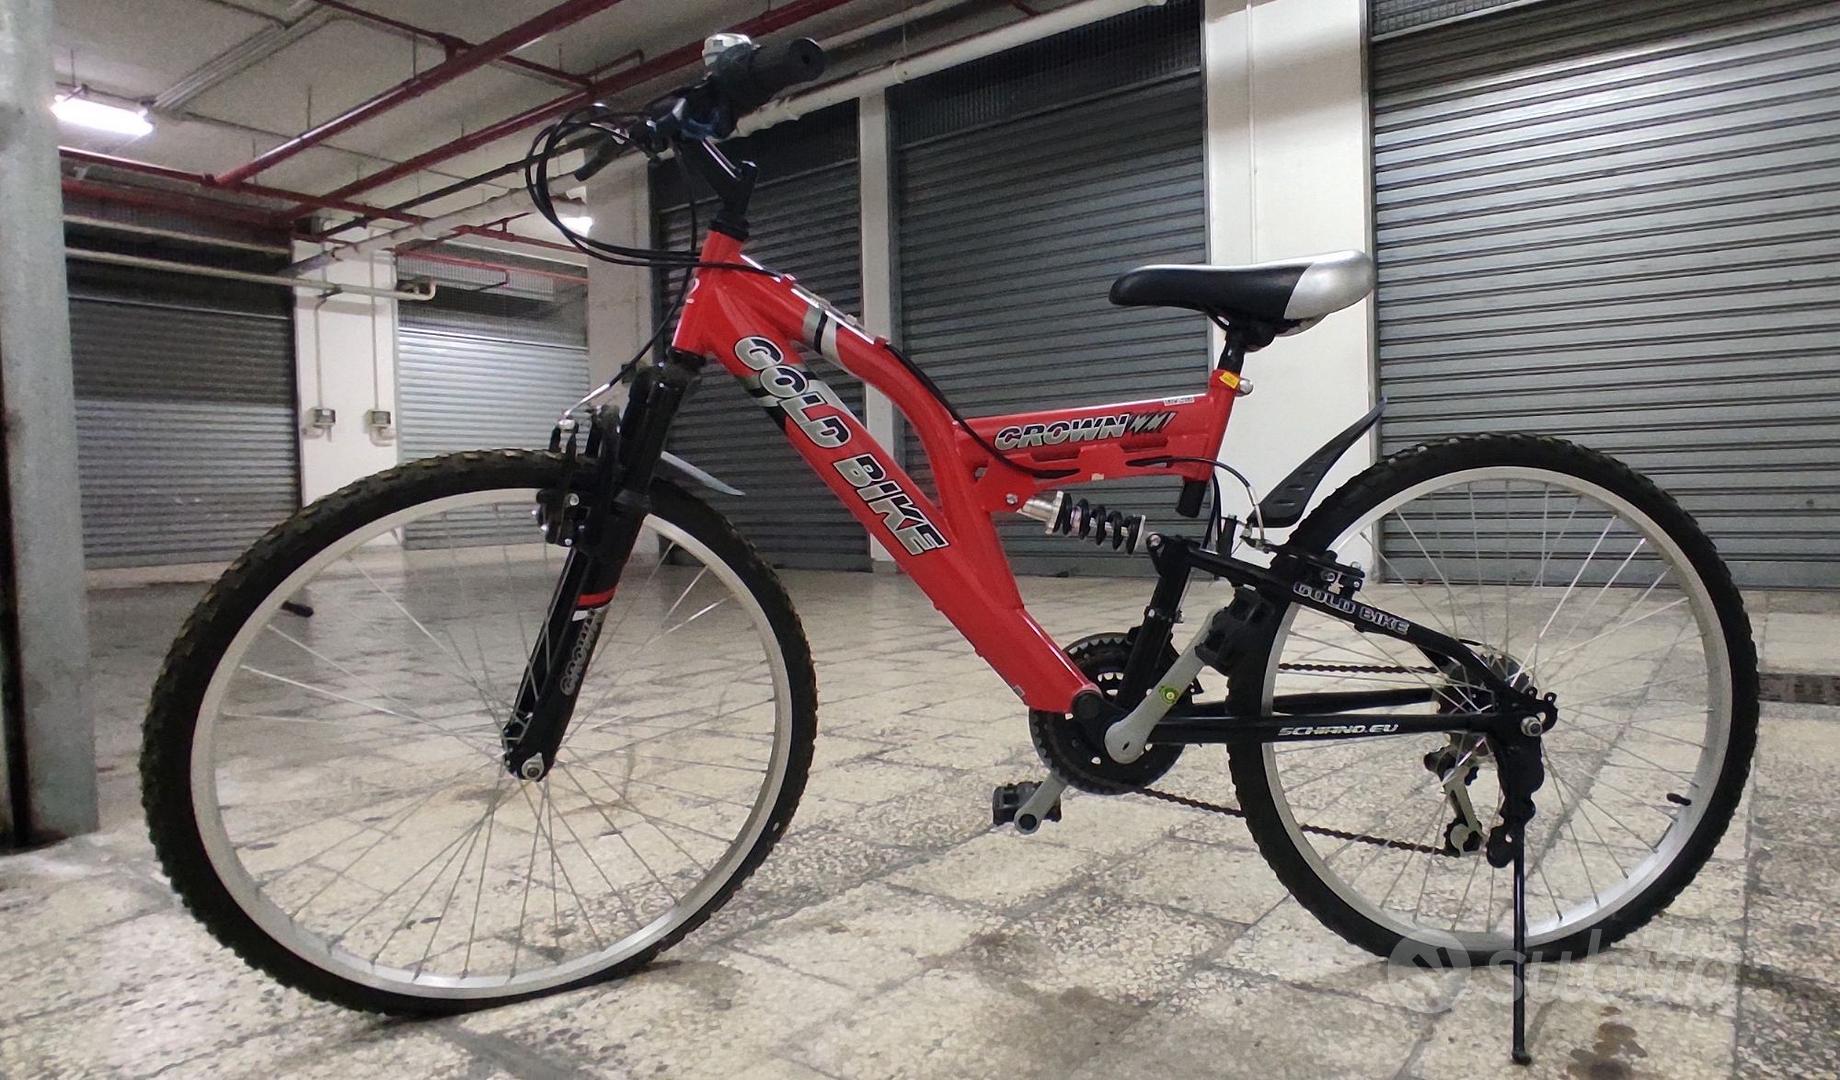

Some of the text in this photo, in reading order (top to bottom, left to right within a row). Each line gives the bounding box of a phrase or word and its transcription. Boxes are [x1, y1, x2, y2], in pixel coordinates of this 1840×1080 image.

[734, 336, 949, 556] GOLD BIKE
[994, 413, 1130, 451] CROWN
[1293, 583, 1410, 634] GOLD BIKE
